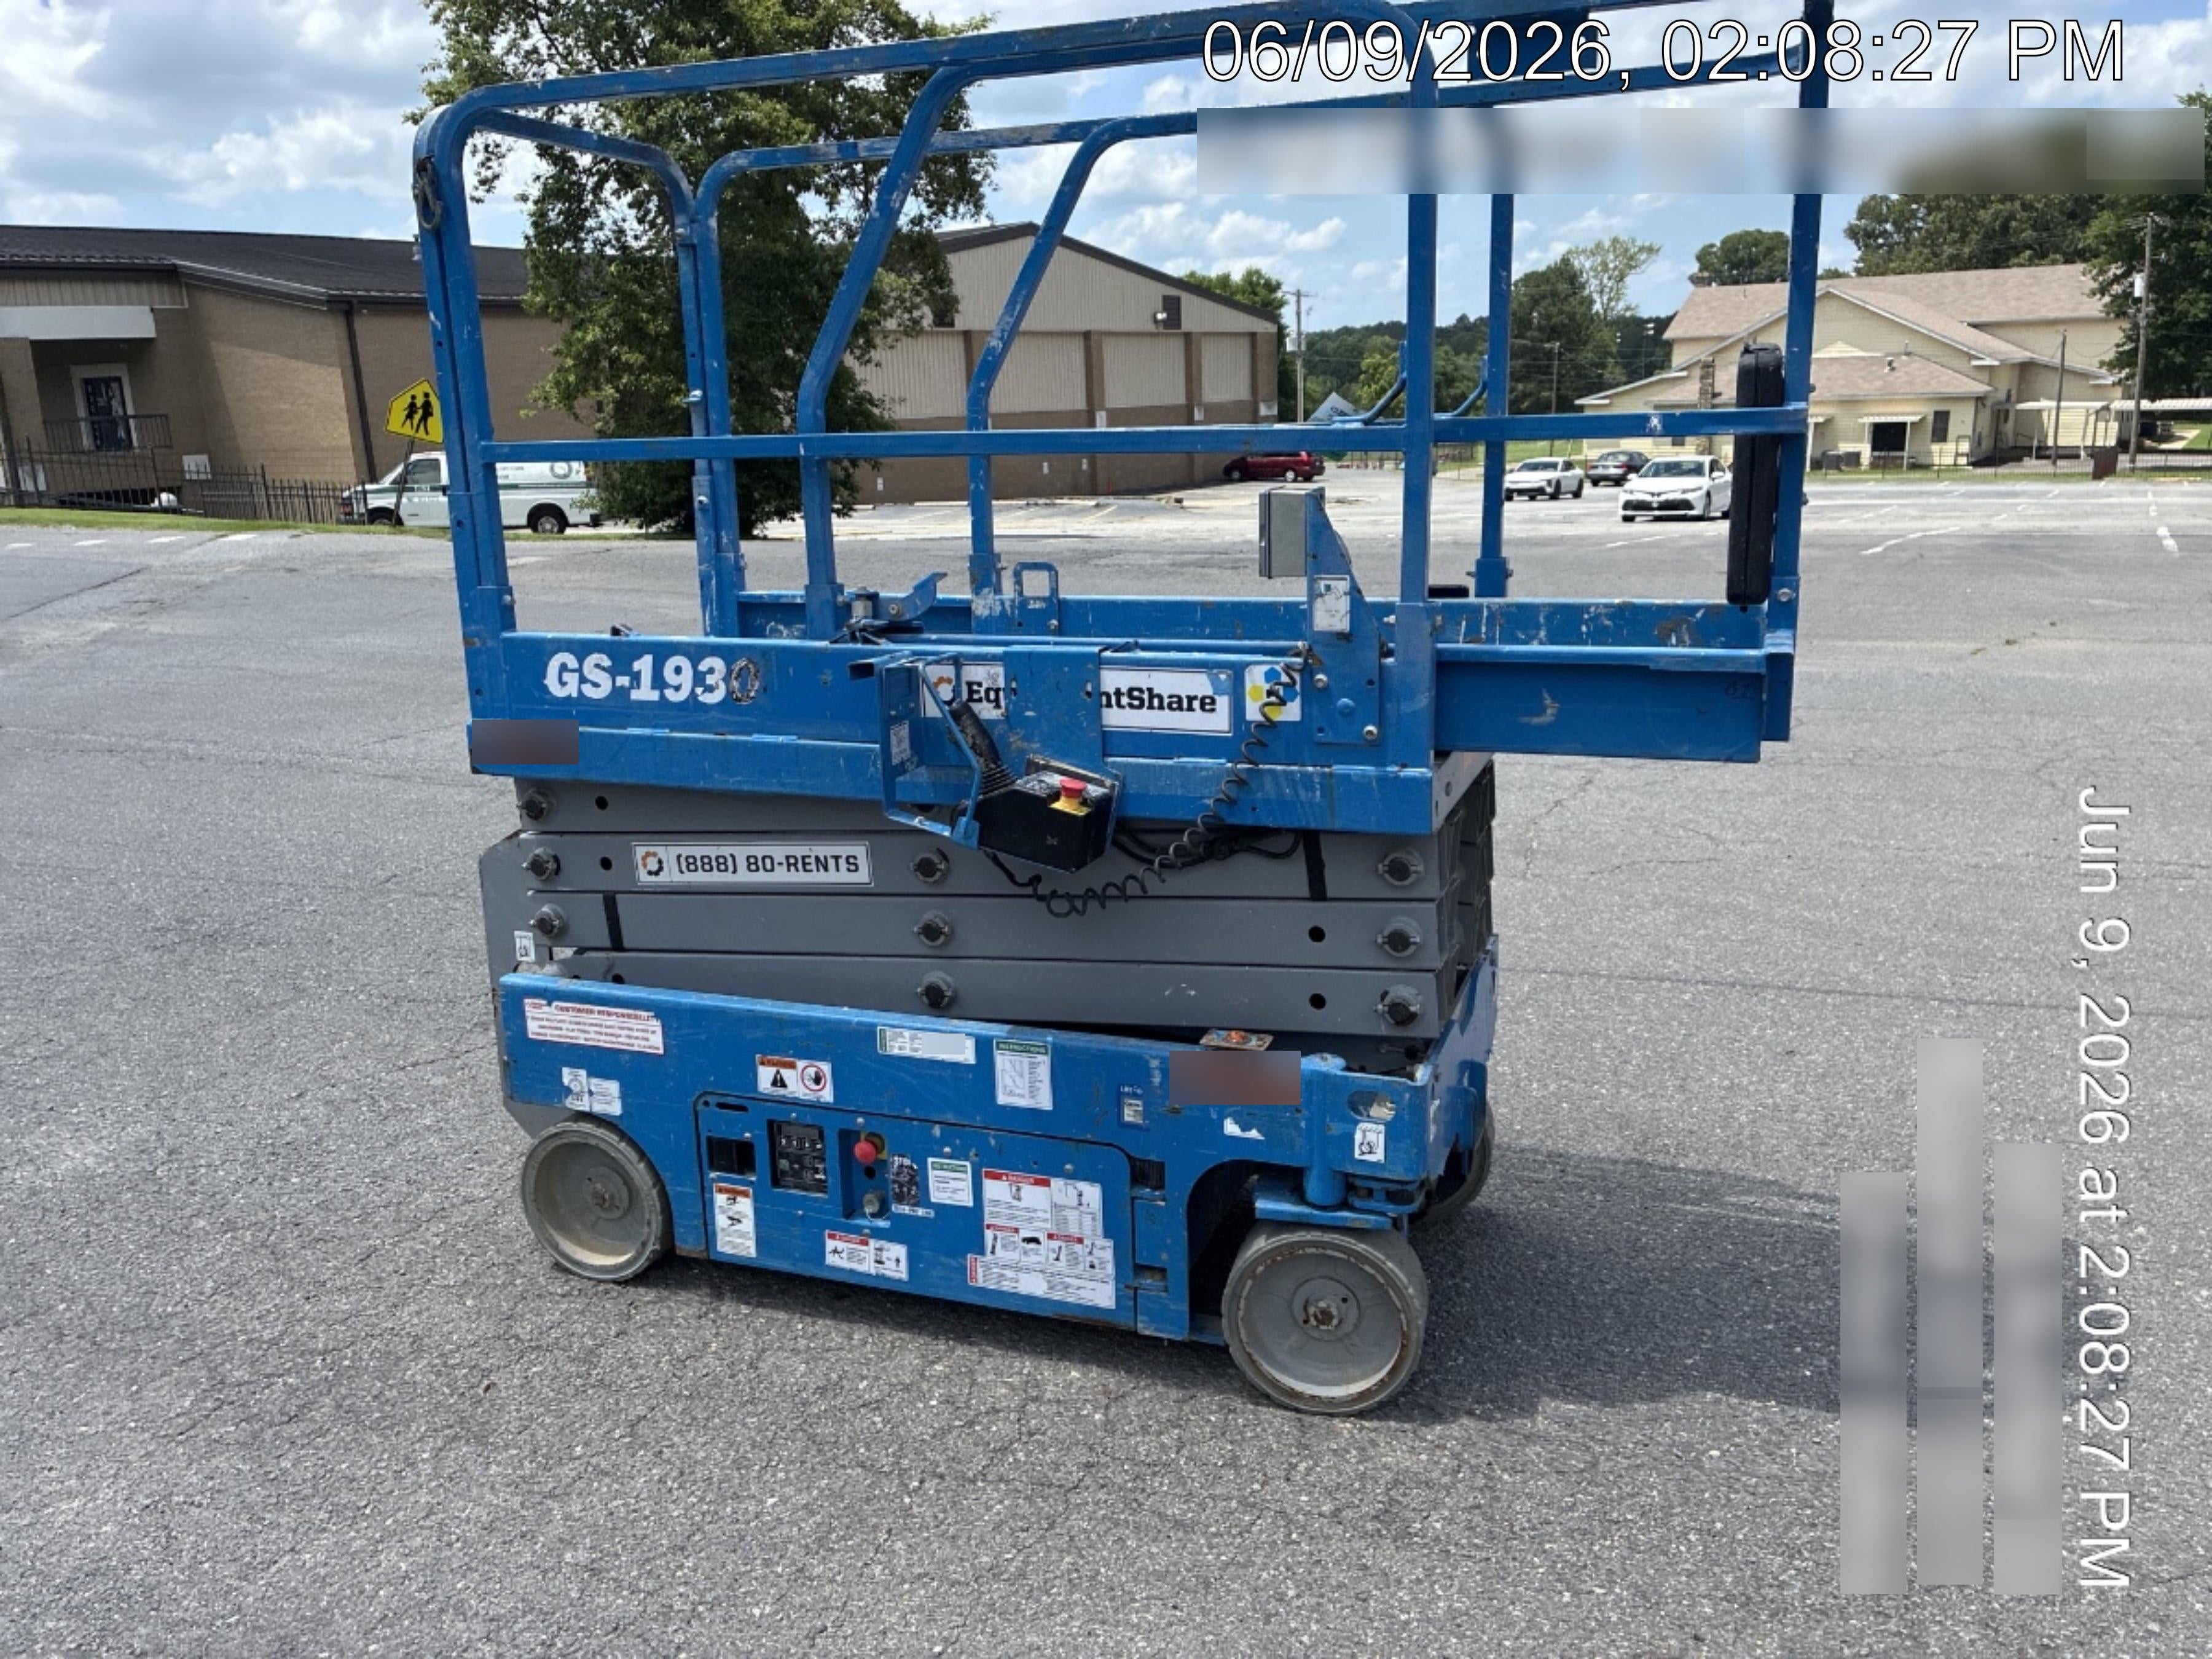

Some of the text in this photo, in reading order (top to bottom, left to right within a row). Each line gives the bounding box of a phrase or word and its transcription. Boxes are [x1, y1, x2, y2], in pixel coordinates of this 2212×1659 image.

[544, 652, 761, 705] GS-1930
[677, 853, 860, 874] (888) 80-RENTS
